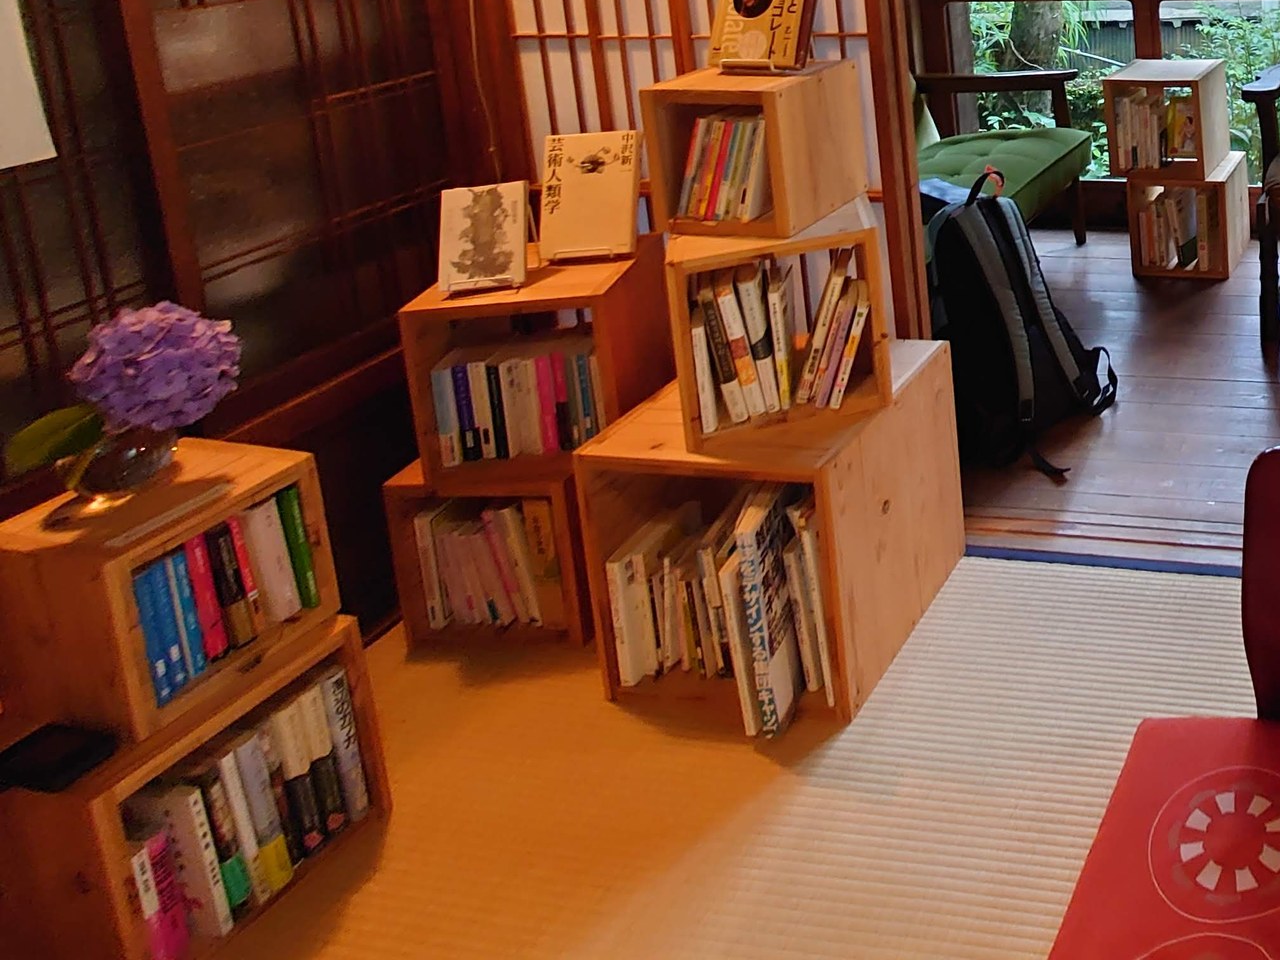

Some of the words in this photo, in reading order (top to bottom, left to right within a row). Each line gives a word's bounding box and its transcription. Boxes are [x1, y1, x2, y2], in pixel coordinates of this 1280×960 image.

[544, 137, 565, 215] 芸術人類学
